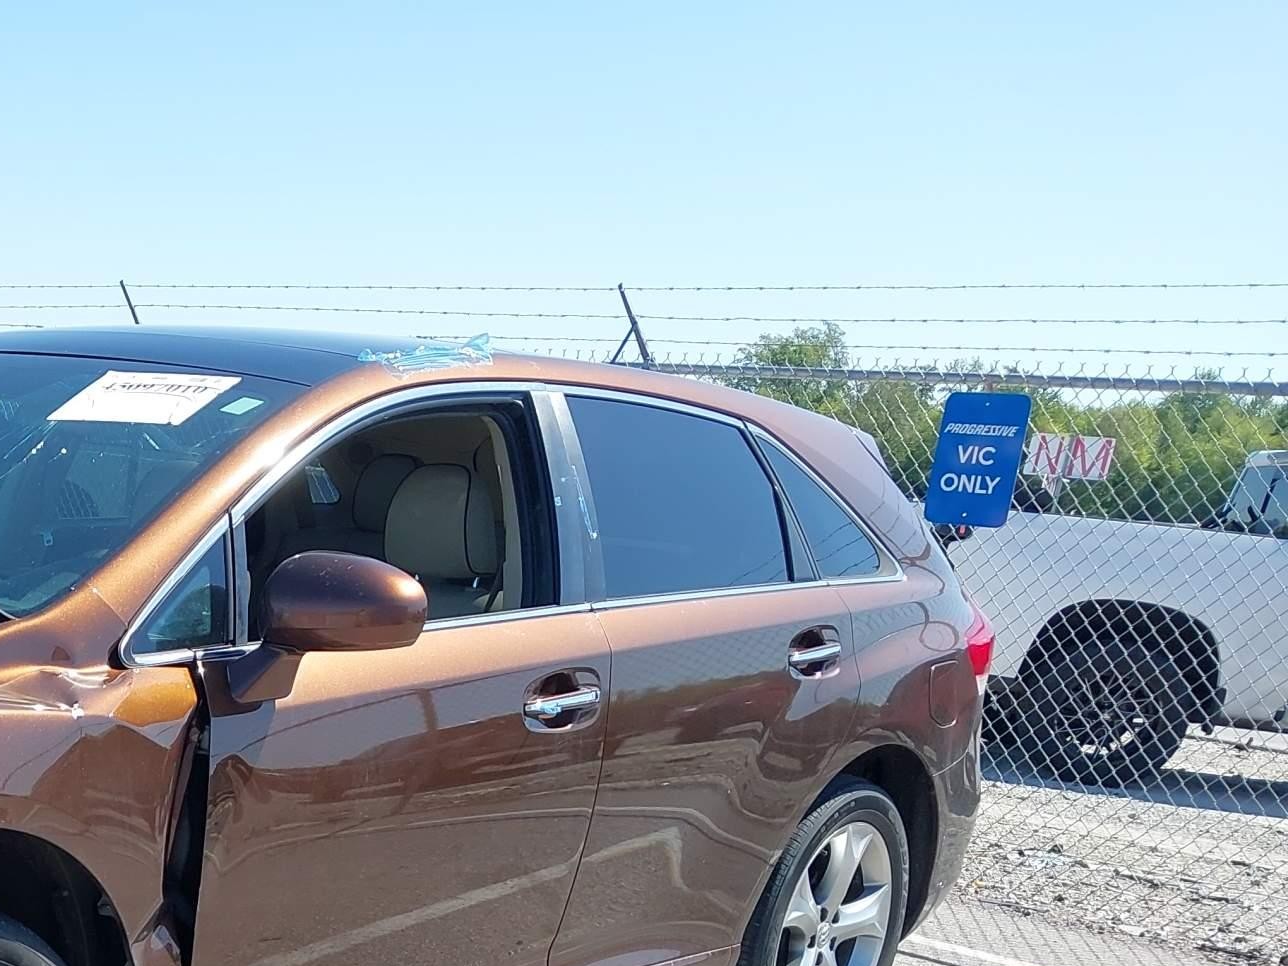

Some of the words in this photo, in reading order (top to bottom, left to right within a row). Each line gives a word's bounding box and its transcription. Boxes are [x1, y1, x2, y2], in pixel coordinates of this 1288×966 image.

[944, 423, 1020, 437] PROGRESSIVE
[958, 445, 997, 466] VIC
[940, 473, 1001, 495] ONLY
